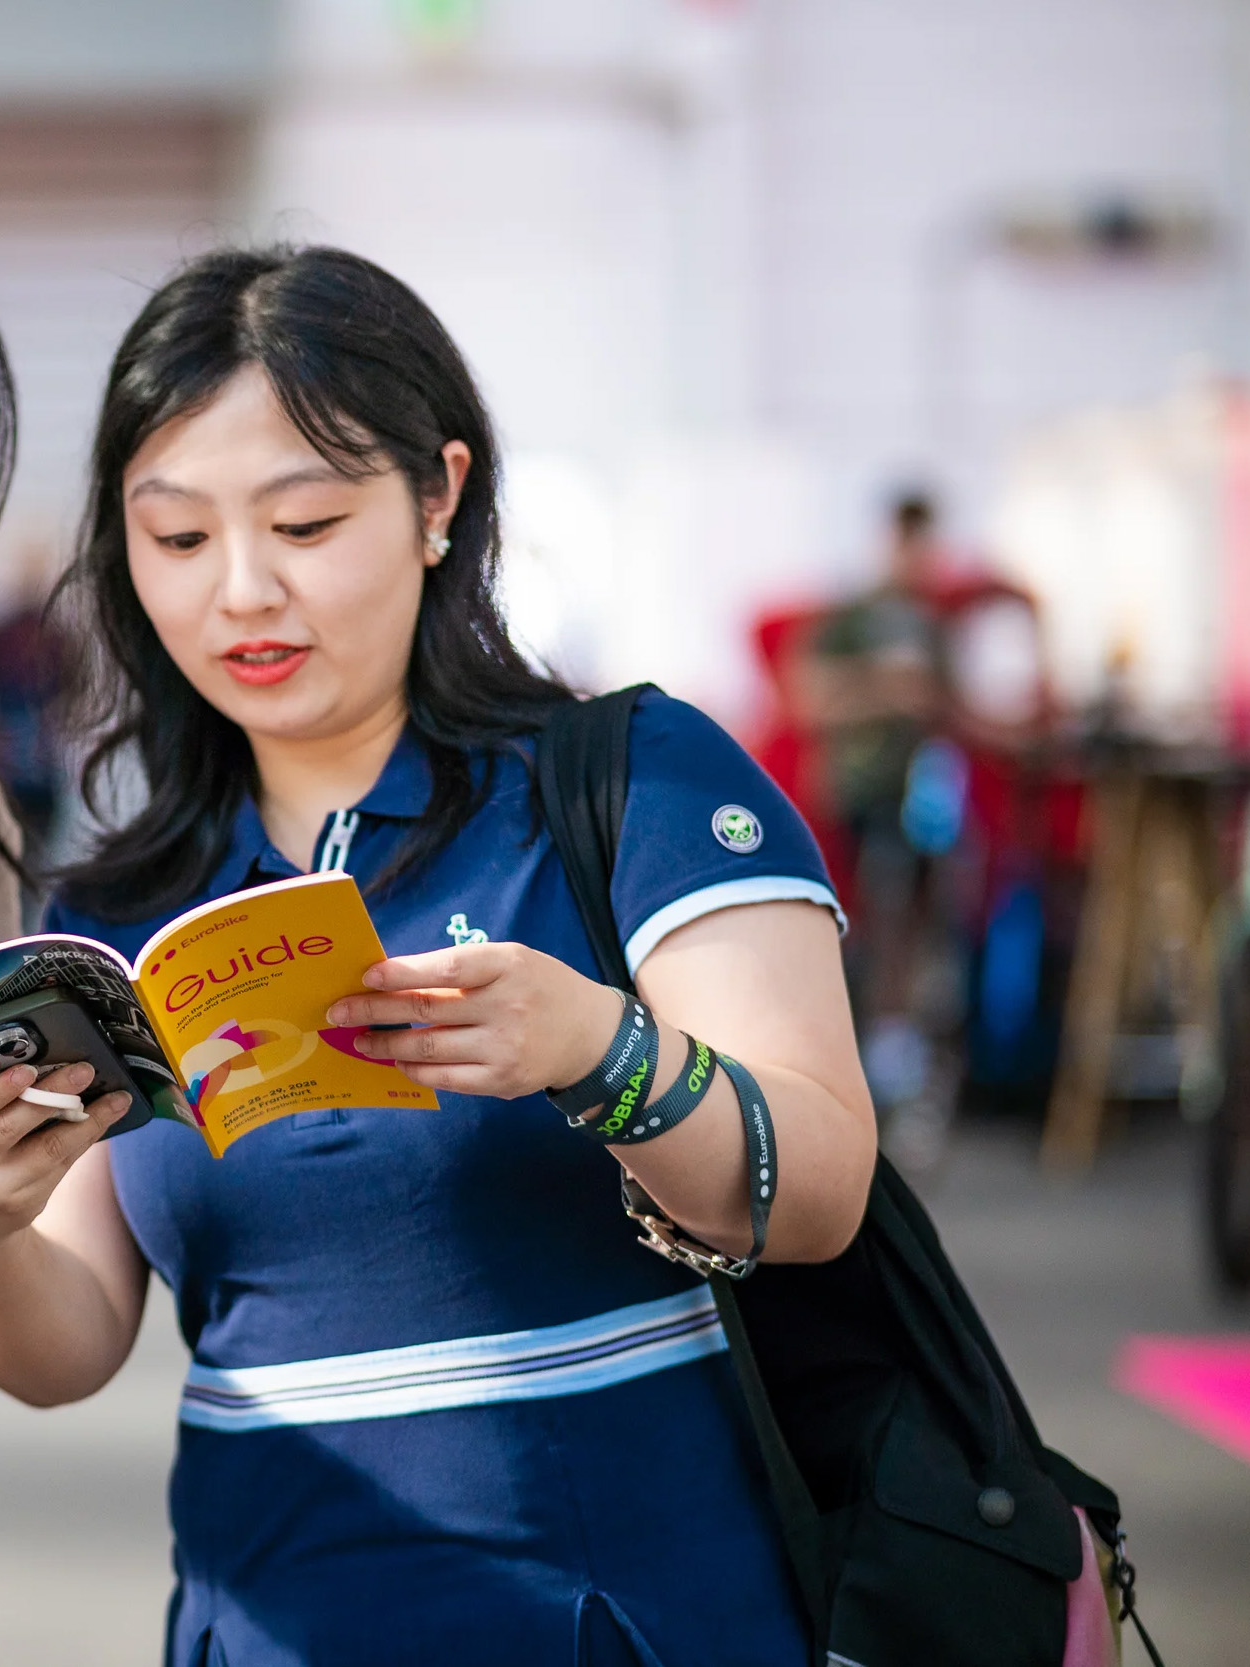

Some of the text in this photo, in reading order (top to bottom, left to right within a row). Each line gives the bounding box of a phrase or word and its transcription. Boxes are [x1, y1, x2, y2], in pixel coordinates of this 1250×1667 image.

[44, 950, 93, 961] DEKRA
[180, 914, 249, 949] Eurobike
[165, 934, 334, 1013] Guide
[176, 971, 284, 1029] Join the global platform for
[178, 981, 269, 1033] cycling and ecomobility
[605, 1028, 641, 1083] Eurobike
[222, 1105, 245, 1122] June
[288, 1080, 318, 1090] 2025
[224, 1089, 312, 1128] Messe Frankfurt
[753, 1103, 768, 1164] Eurobike
